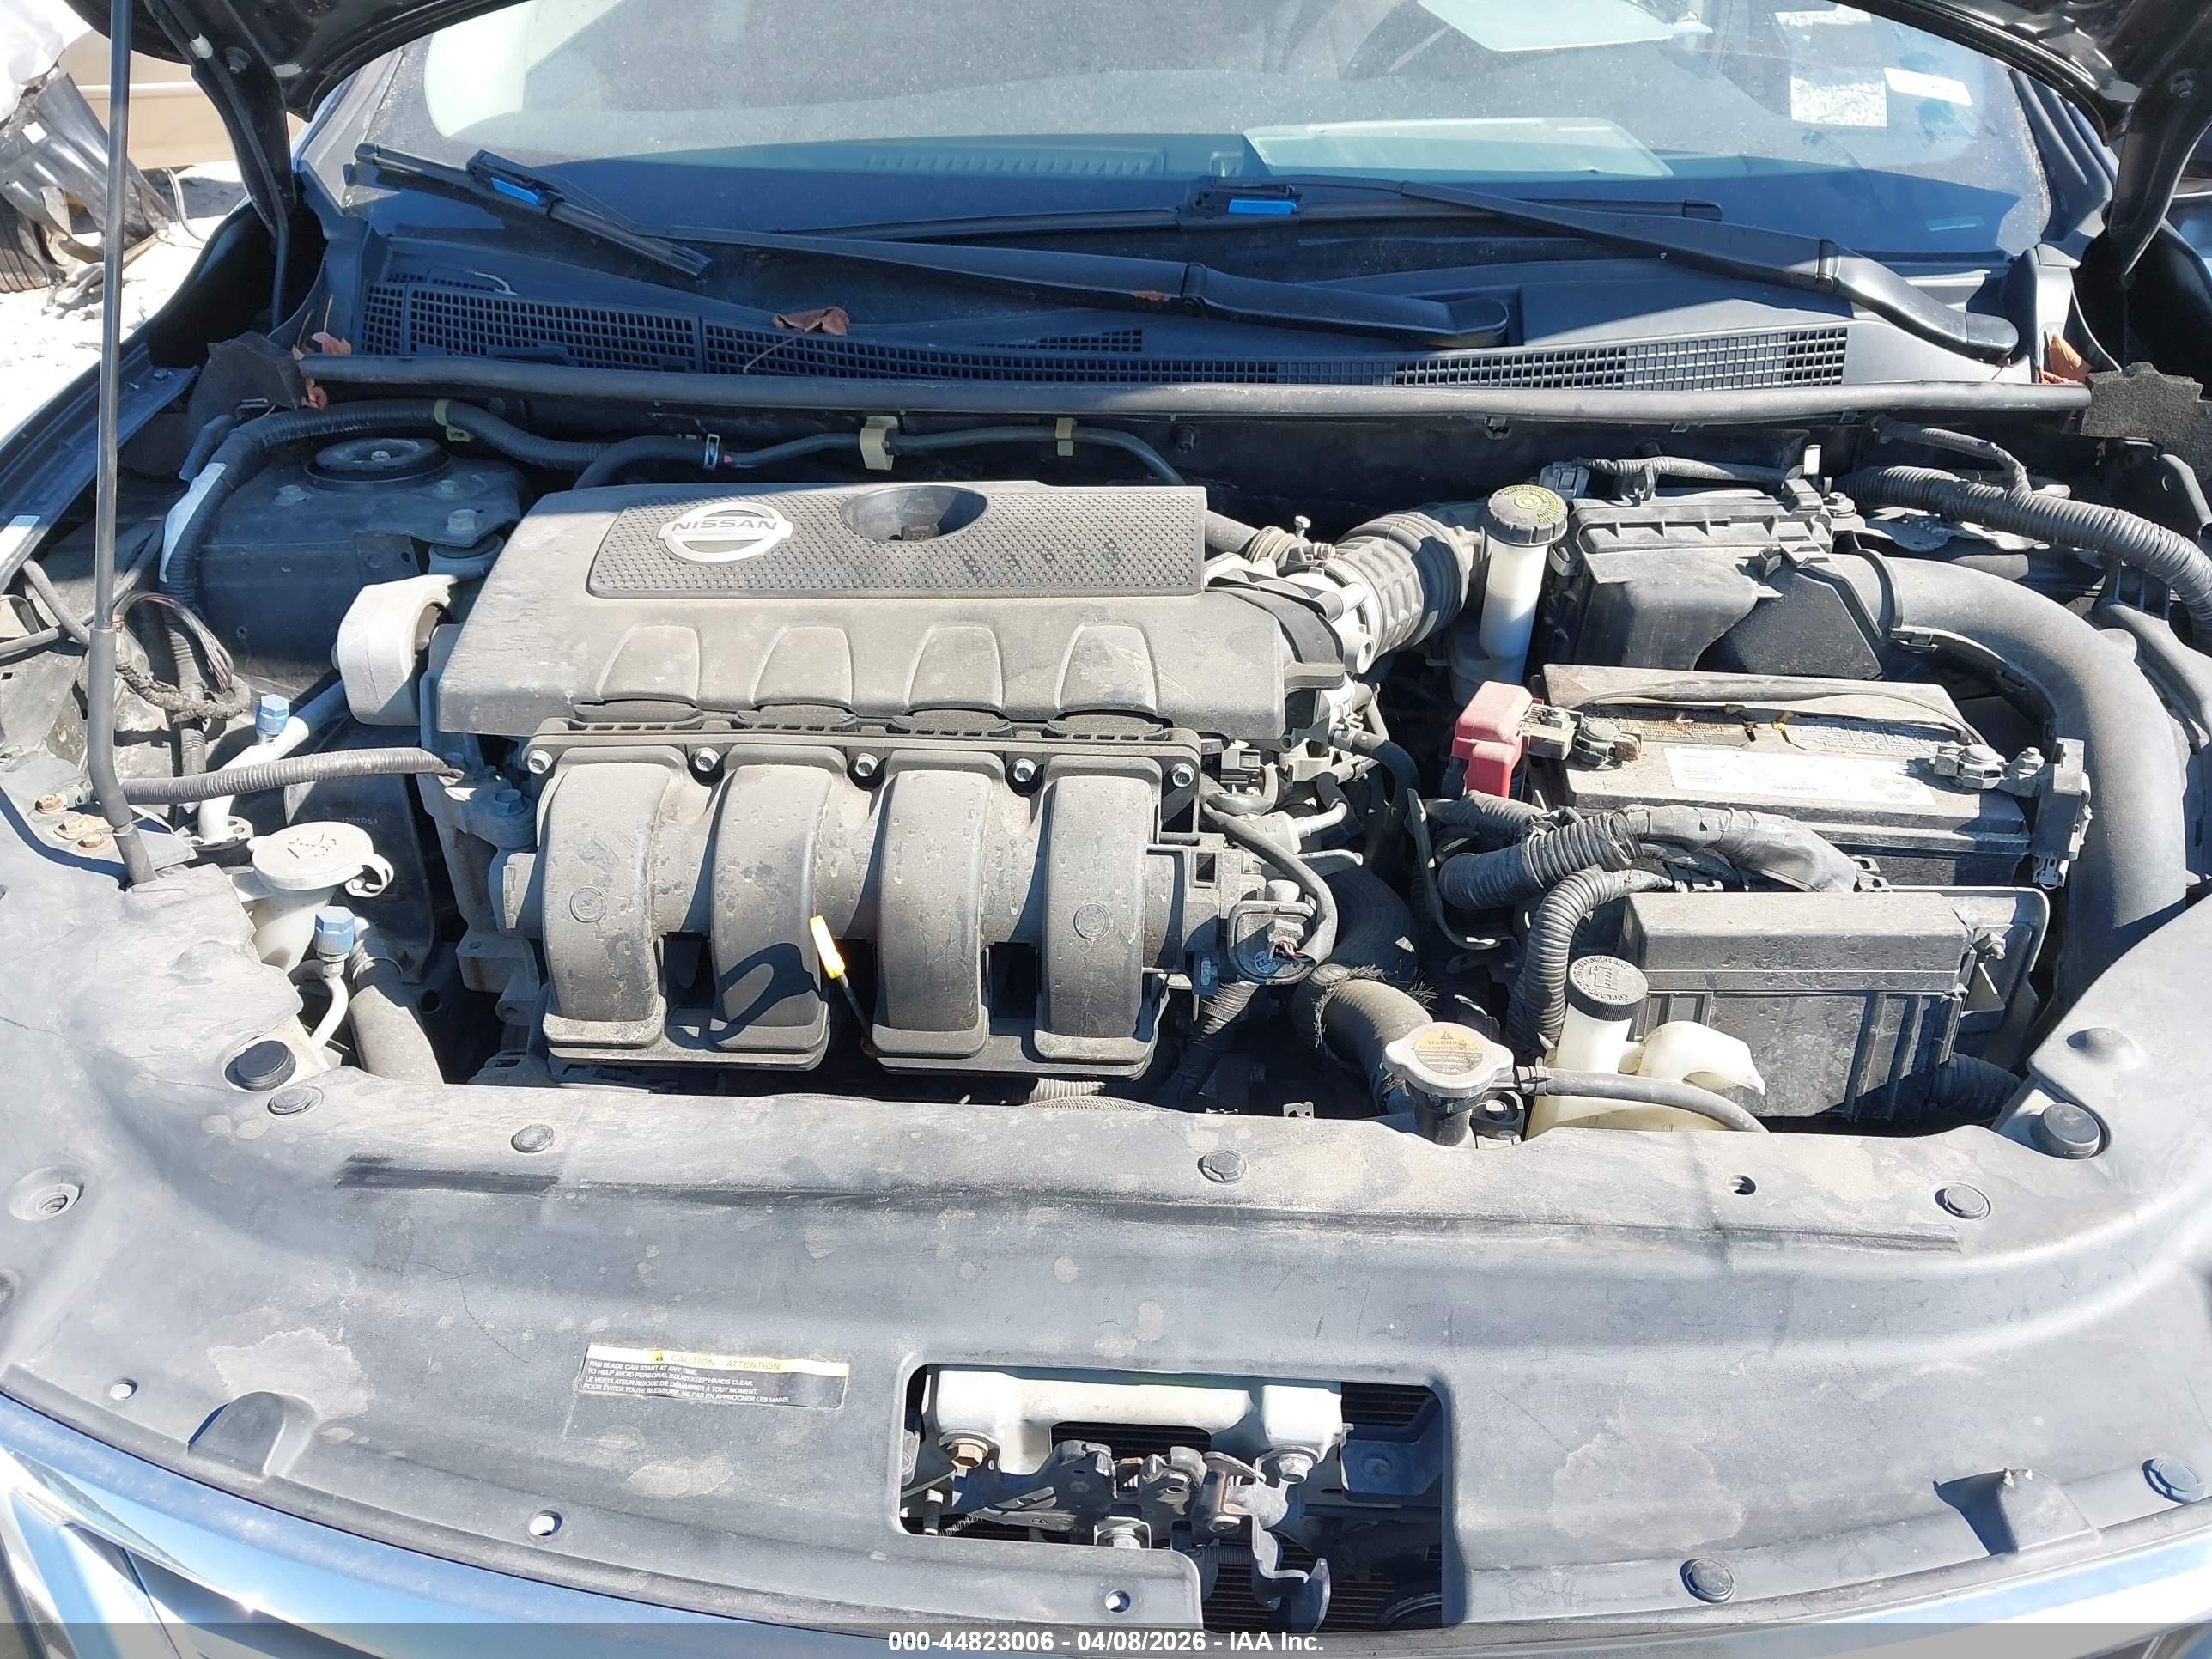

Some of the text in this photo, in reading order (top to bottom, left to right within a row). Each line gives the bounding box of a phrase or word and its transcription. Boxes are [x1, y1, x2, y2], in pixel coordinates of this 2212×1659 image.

[672, 519, 778, 532] NISSAN
[603, 1361, 624, 1370] BLADE
[624, 1362, 640, 1370] CAN
[640, 1363, 658, 1371] START
[671, 1354, 714, 1366] CAUTION
[726, 1359, 781, 1370] ATTENTION
[594, 1376, 635, 1386] VENTILATEUR
[670, 1381, 705, 1391] DÉMARRER
[705, 1383, 710, 1392] À
[708, 1376, 731, 1385] HANDS
[602, 1383, 624, 1392] ÉVITER
[714, 1394, 756, 1402] APPROCHER
